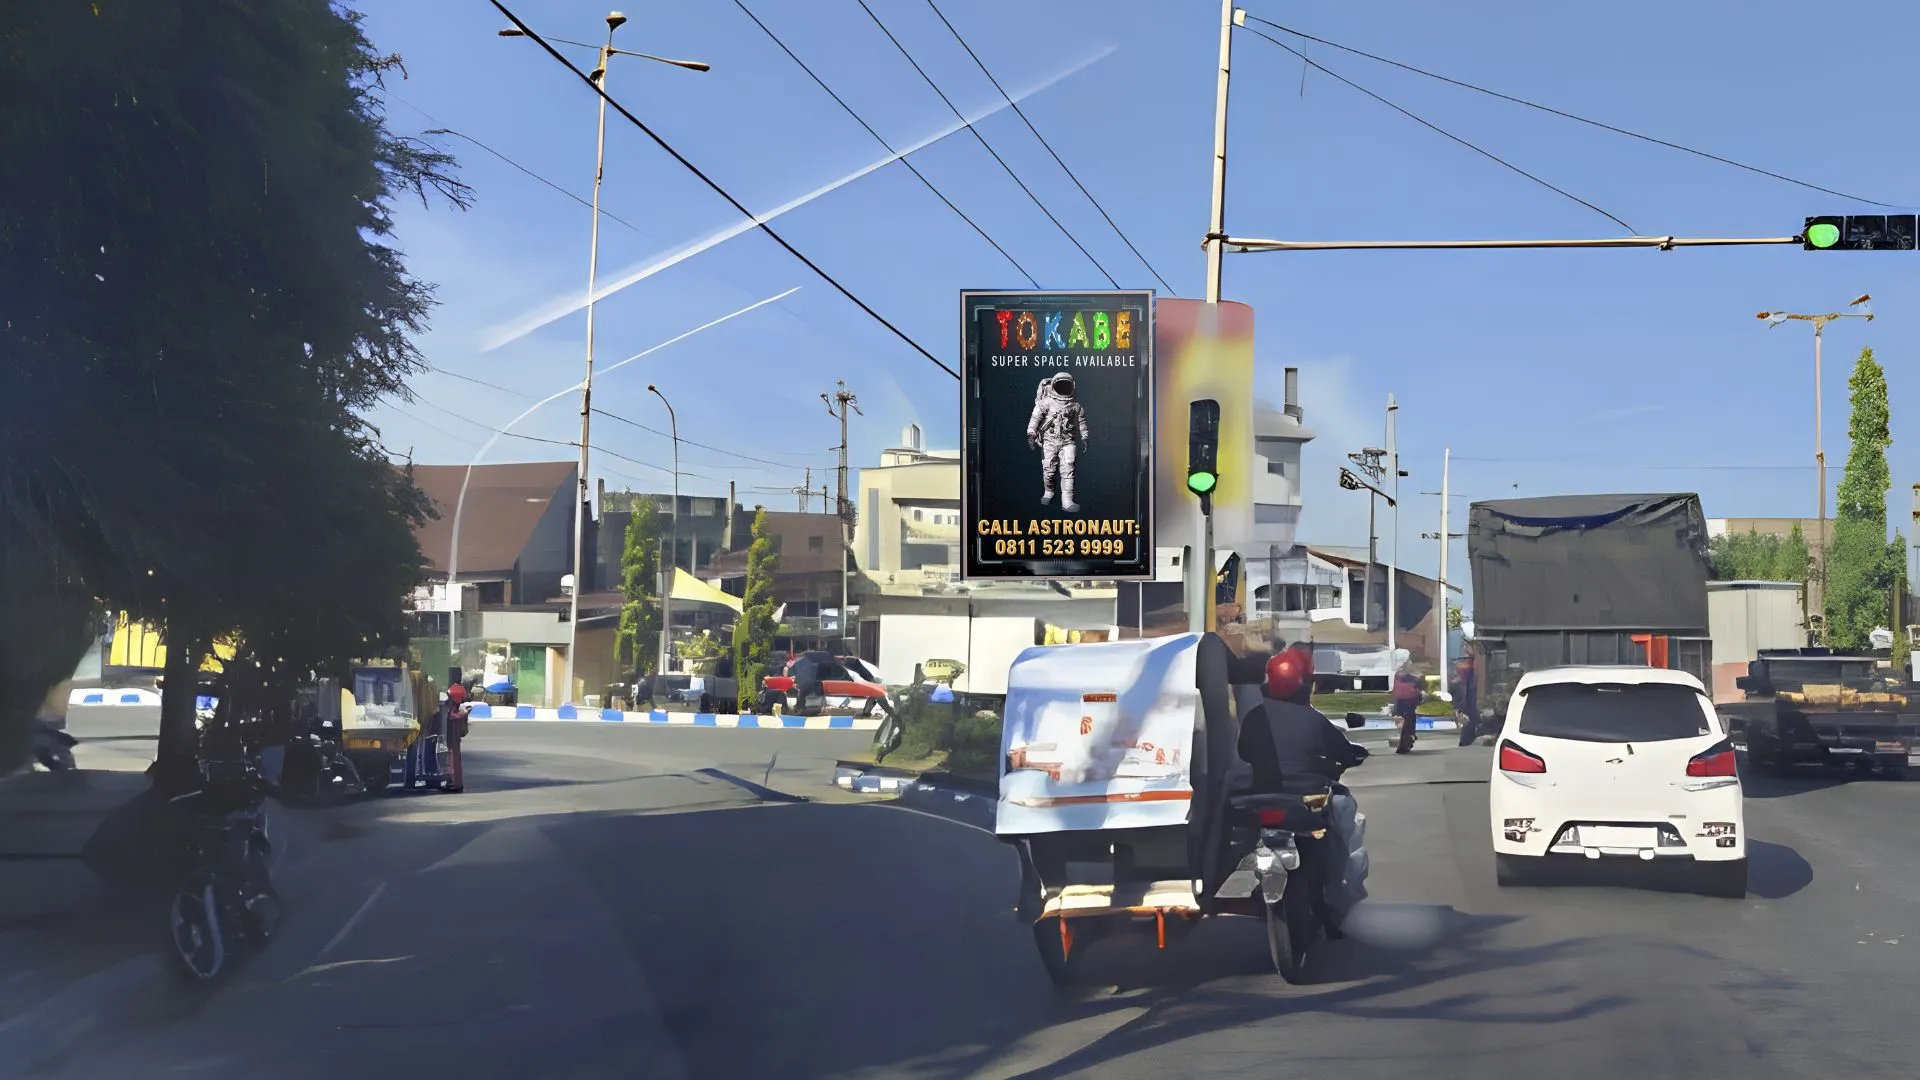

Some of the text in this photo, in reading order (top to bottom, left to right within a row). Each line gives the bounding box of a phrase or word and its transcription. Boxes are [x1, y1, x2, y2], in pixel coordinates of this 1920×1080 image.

[995, 309, 1131, 350] TOKABE
[991, 355, 1136, 367] SUPER SPACE AVAILABLE
[978, 519, 1140, 536] CALL ASTRONAUT:
[995, 539, 1124, 556] 0811 523 9999
